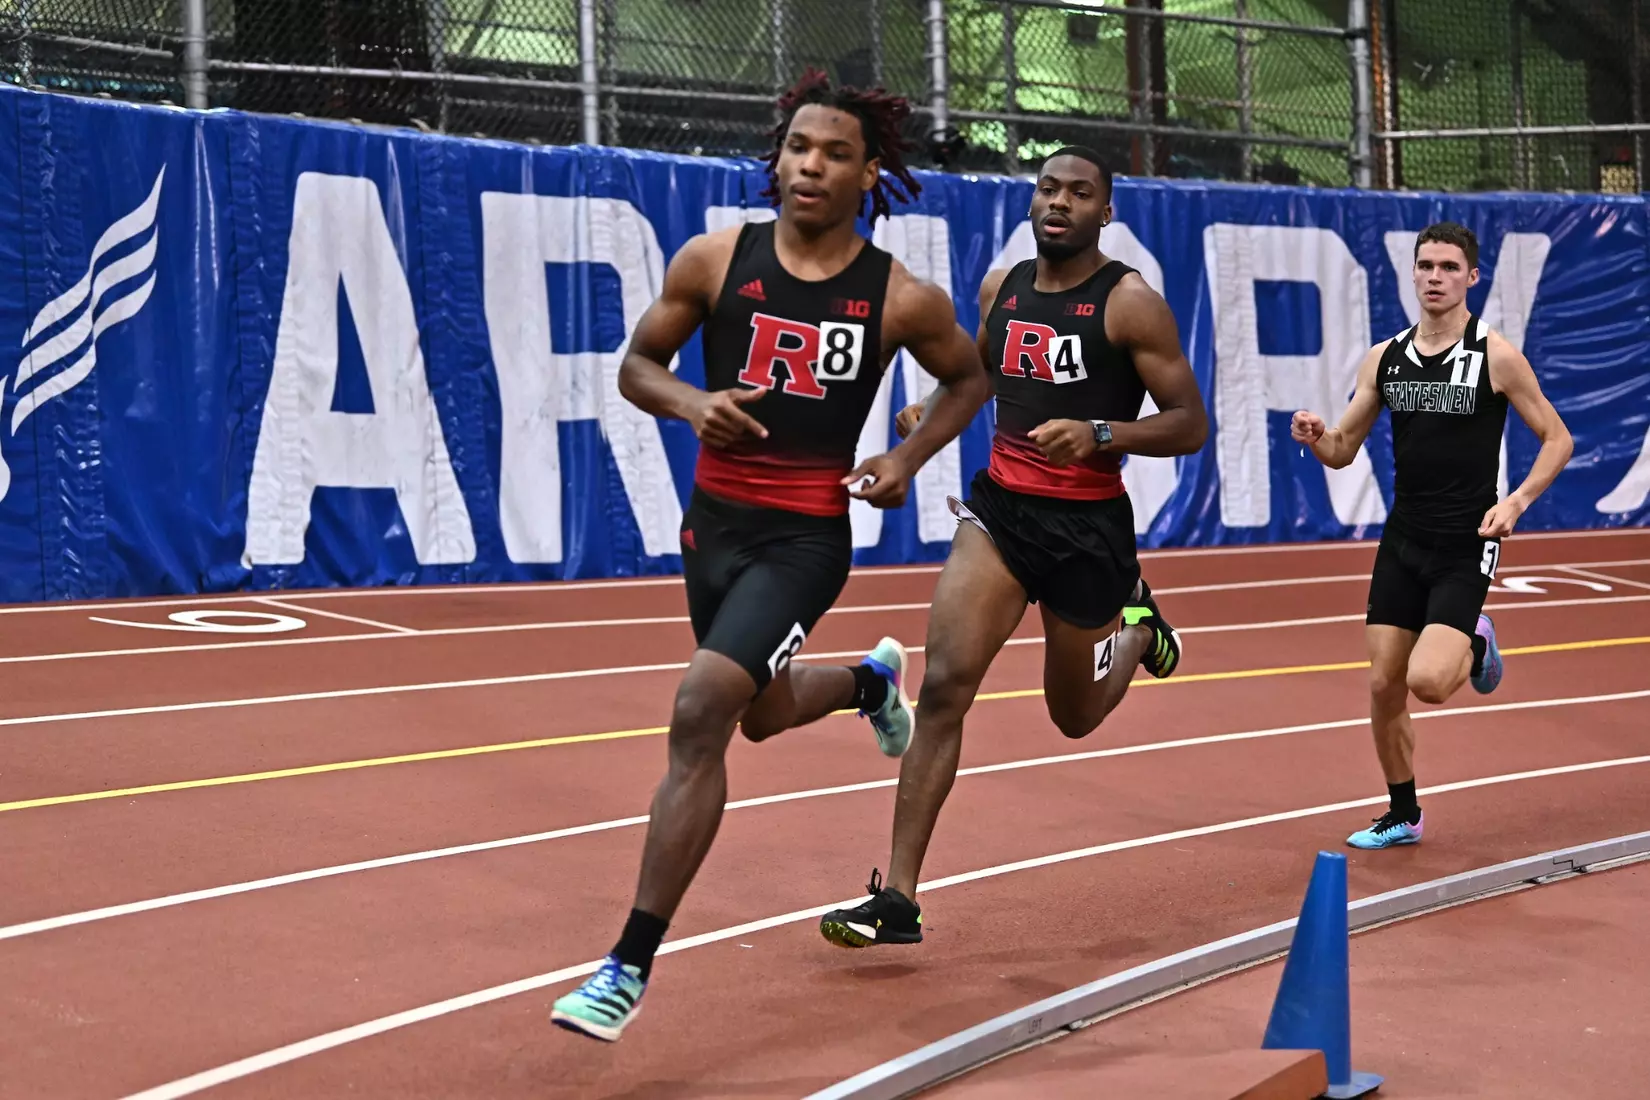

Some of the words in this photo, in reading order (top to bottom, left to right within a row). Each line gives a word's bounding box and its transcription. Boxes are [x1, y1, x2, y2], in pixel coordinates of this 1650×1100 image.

[738, 312, 827, 400] R
[823, 327, 854, 376] 8
[1001, 320, 1057, 382] R
[1055, 338, 1080, 379] 4
[1459, 353, 1473, 384] 1
[1384, 381, 1477, 415] STATESMEN
[1097, 637, 1113, 671] 4
